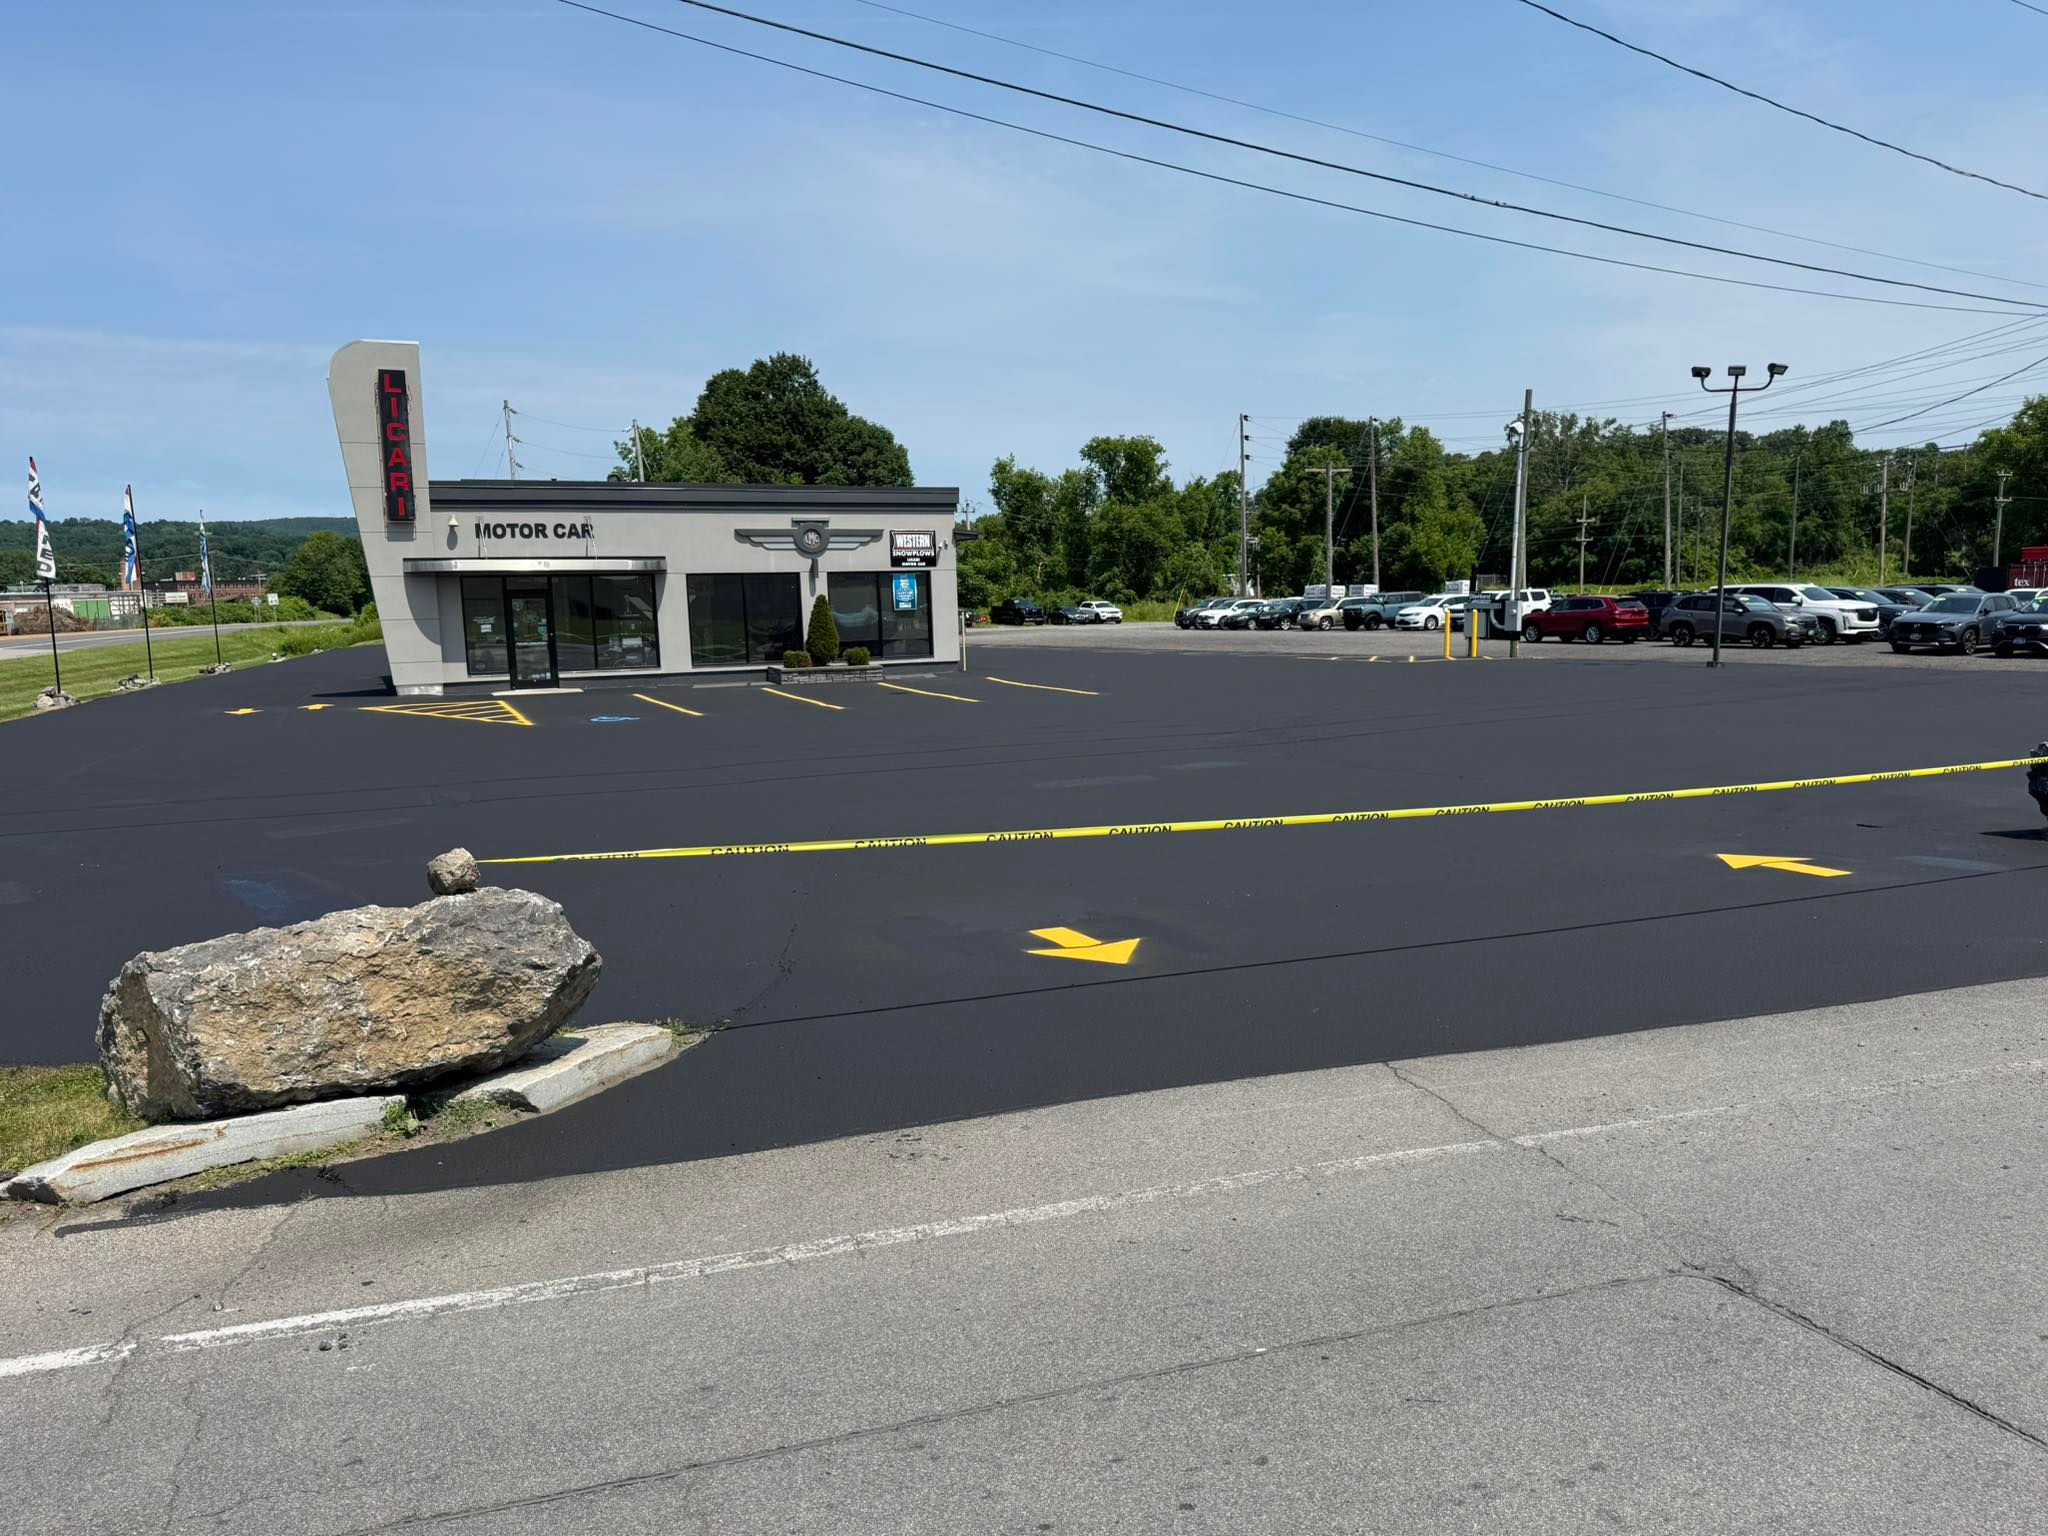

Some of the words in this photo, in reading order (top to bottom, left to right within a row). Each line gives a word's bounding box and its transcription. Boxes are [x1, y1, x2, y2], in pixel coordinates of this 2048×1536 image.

[384, 373, 410, 516] LICARI
[475, 523, 548, 539] MOTOR
[553, 523, 594, 539] CAR
[895, 534, 931, 548] WESTERN
[892, 549, 935, 557] SNOWPLOWS
[2014, 577, 2030, 587] tex
[711, 844, 789, 855] CAUTION
[855, 837, 926, 848] CAUTION
[987, 831, 1053, 841] CAUTION
[1109, 824, 1172, 836] CAUTION
[1224, 819, 1283, 829] CAUTION
[1332, 812, 1389, 822] CAUTION
[1435, 806, 1490, 816] CAUTION
[1533, 799, 1585, 809] CAUTION
[1625, 793, 1674, 802] CAUTION
[1712, 786, 1757, 795] CAUTION
[1793, 779, 1836, 788] CAUTION
[1870, 772, 1910, 781] CAUTION
[1943, 765, 1981, 774] CAUTION
